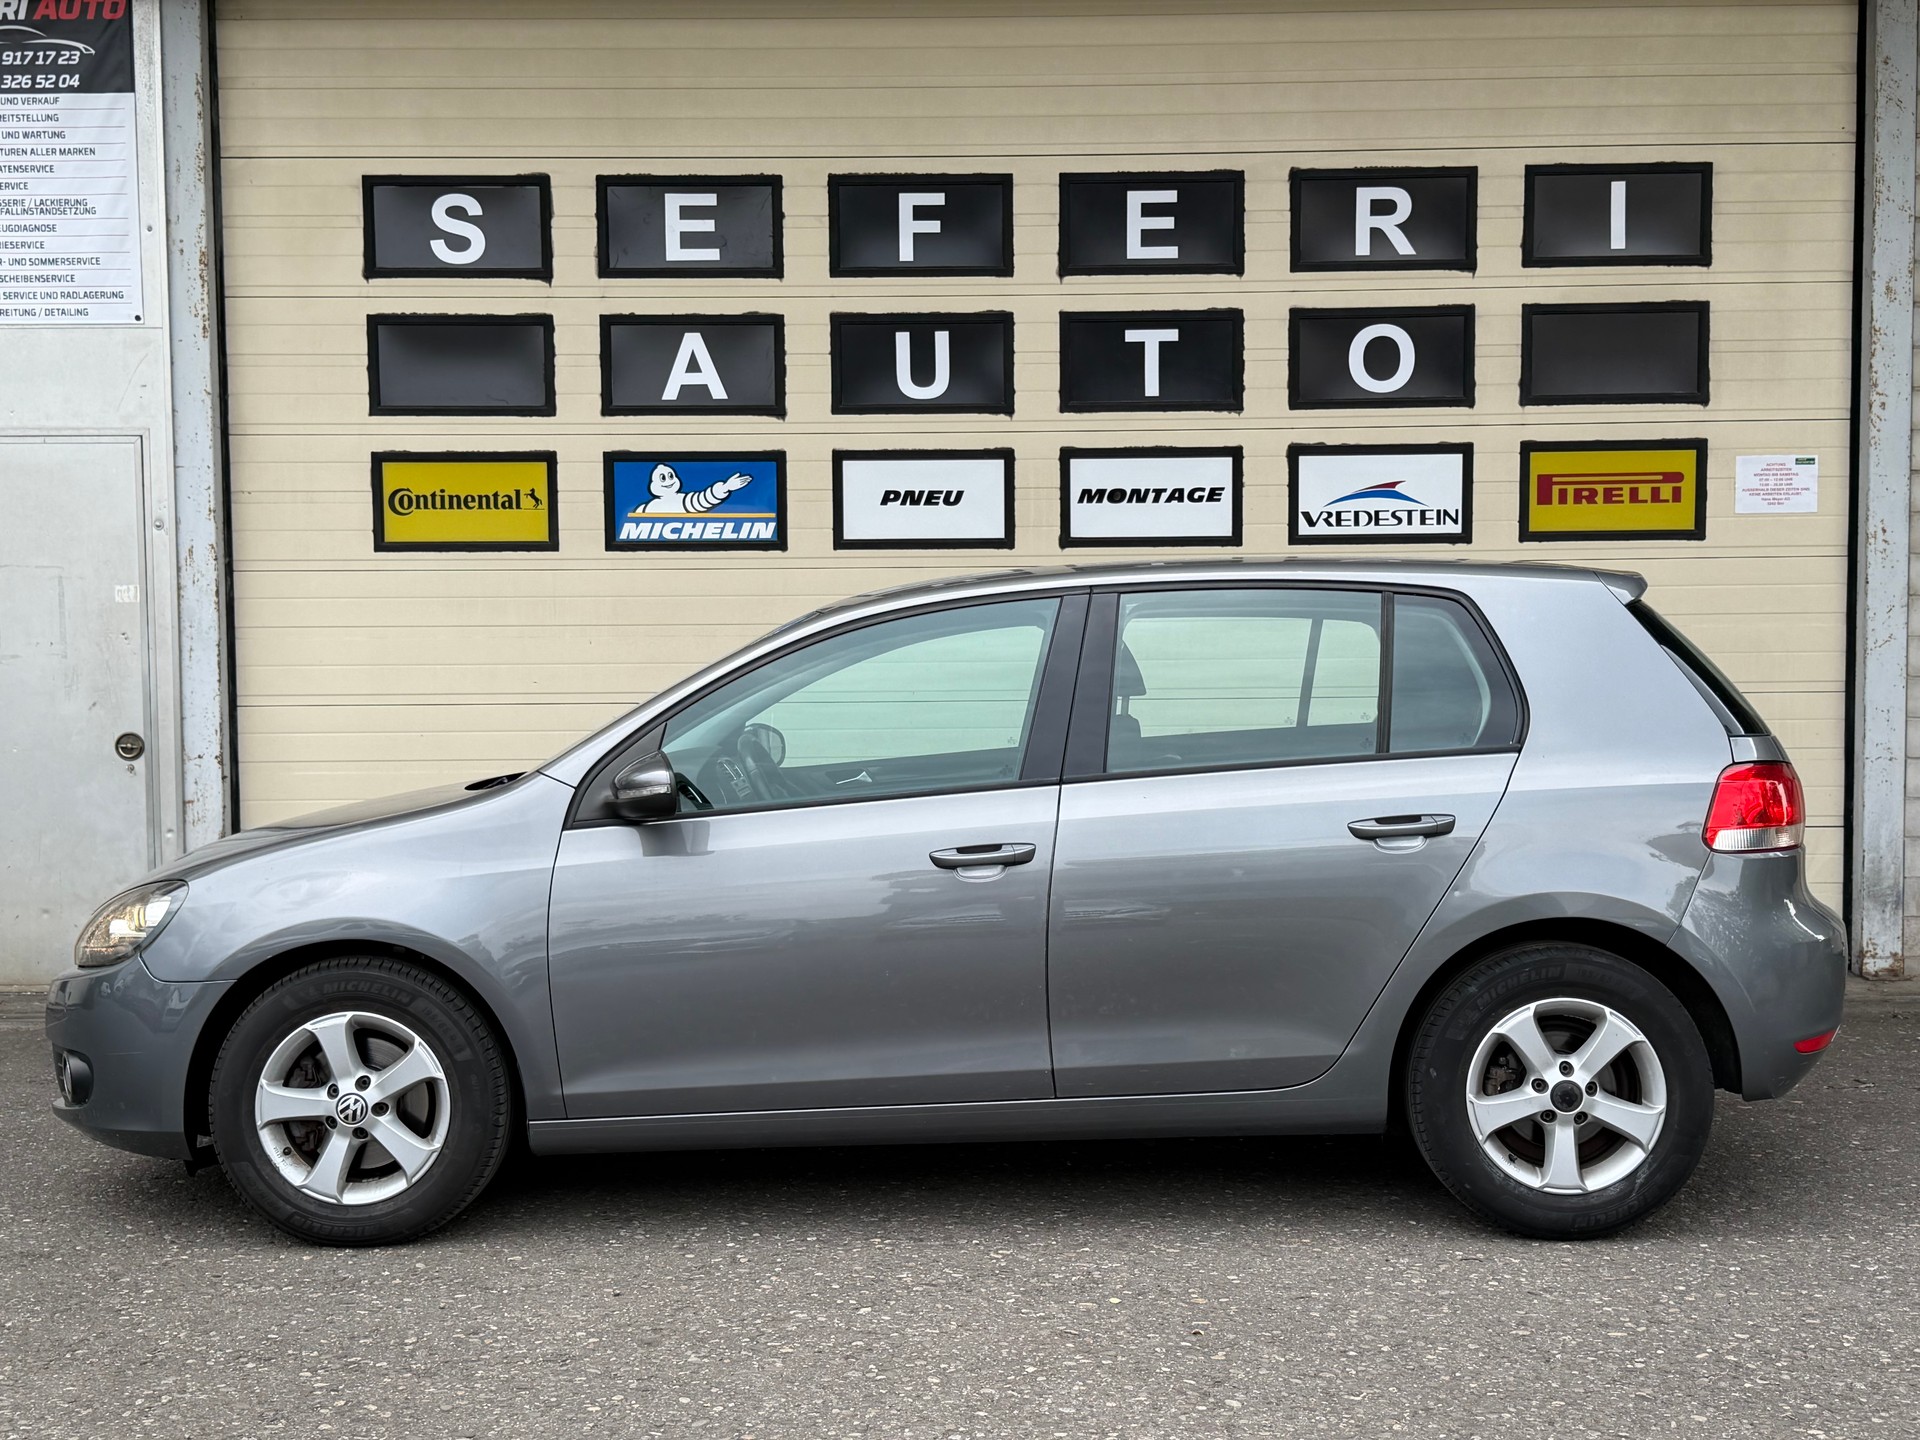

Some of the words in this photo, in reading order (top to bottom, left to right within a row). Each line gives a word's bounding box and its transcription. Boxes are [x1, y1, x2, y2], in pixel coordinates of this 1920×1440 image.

[33, 0, 126, 20] AUTO
[2, 51, 34, 65] 917
[35, 51, 56, 65] 17
[57, 50, 81, 65] 23
[0, 74, 32, 89] 326
[34, 74, 56, 89] 52
[58, 73, 80, 88] 04
[0, 96, 19, 106] UND
[20, 96, 60, 105] VERKAUF
[0, 113, 59, 122] EITSTELLUNG
[1, 130, 20, 140] UND
[21, 130, 66, 139] WARTUNG
[29, 147, 57, 156] ALLER
[58, 147, 96, 156] MARKEN
[34, 198, 88, 207] LACKIERUNG
[0, 206, 97, 216] FALLINSTANDSETZUNG
[0, 223, 58, 233] UGDIAGNOSE
[0, 240, 45, 249] IESERVICE
[8, 257, 27, 266] UND
[28, 256, 101, 266] SOMMERSERVICE
[2, 291, 38, 300] SERVICE
[39, 291, 59, 300] UND
[60, 290, 125, 300] RADLAGERUNG
[44, 307, 89, 317] DETAILING
[1536, 471, 1684, 506] PIRELLI
[880, 490, 964, 507] PNEU
[1077, 486, 1225, 505] MONTAGE
[388, 488, 522, 516] Continental
[1300, 508, 1460, 528] VREDESTEIN
[619, 521, 776, 541] MICHELIN
[323, 980, 412, 1005] MICHELIN
